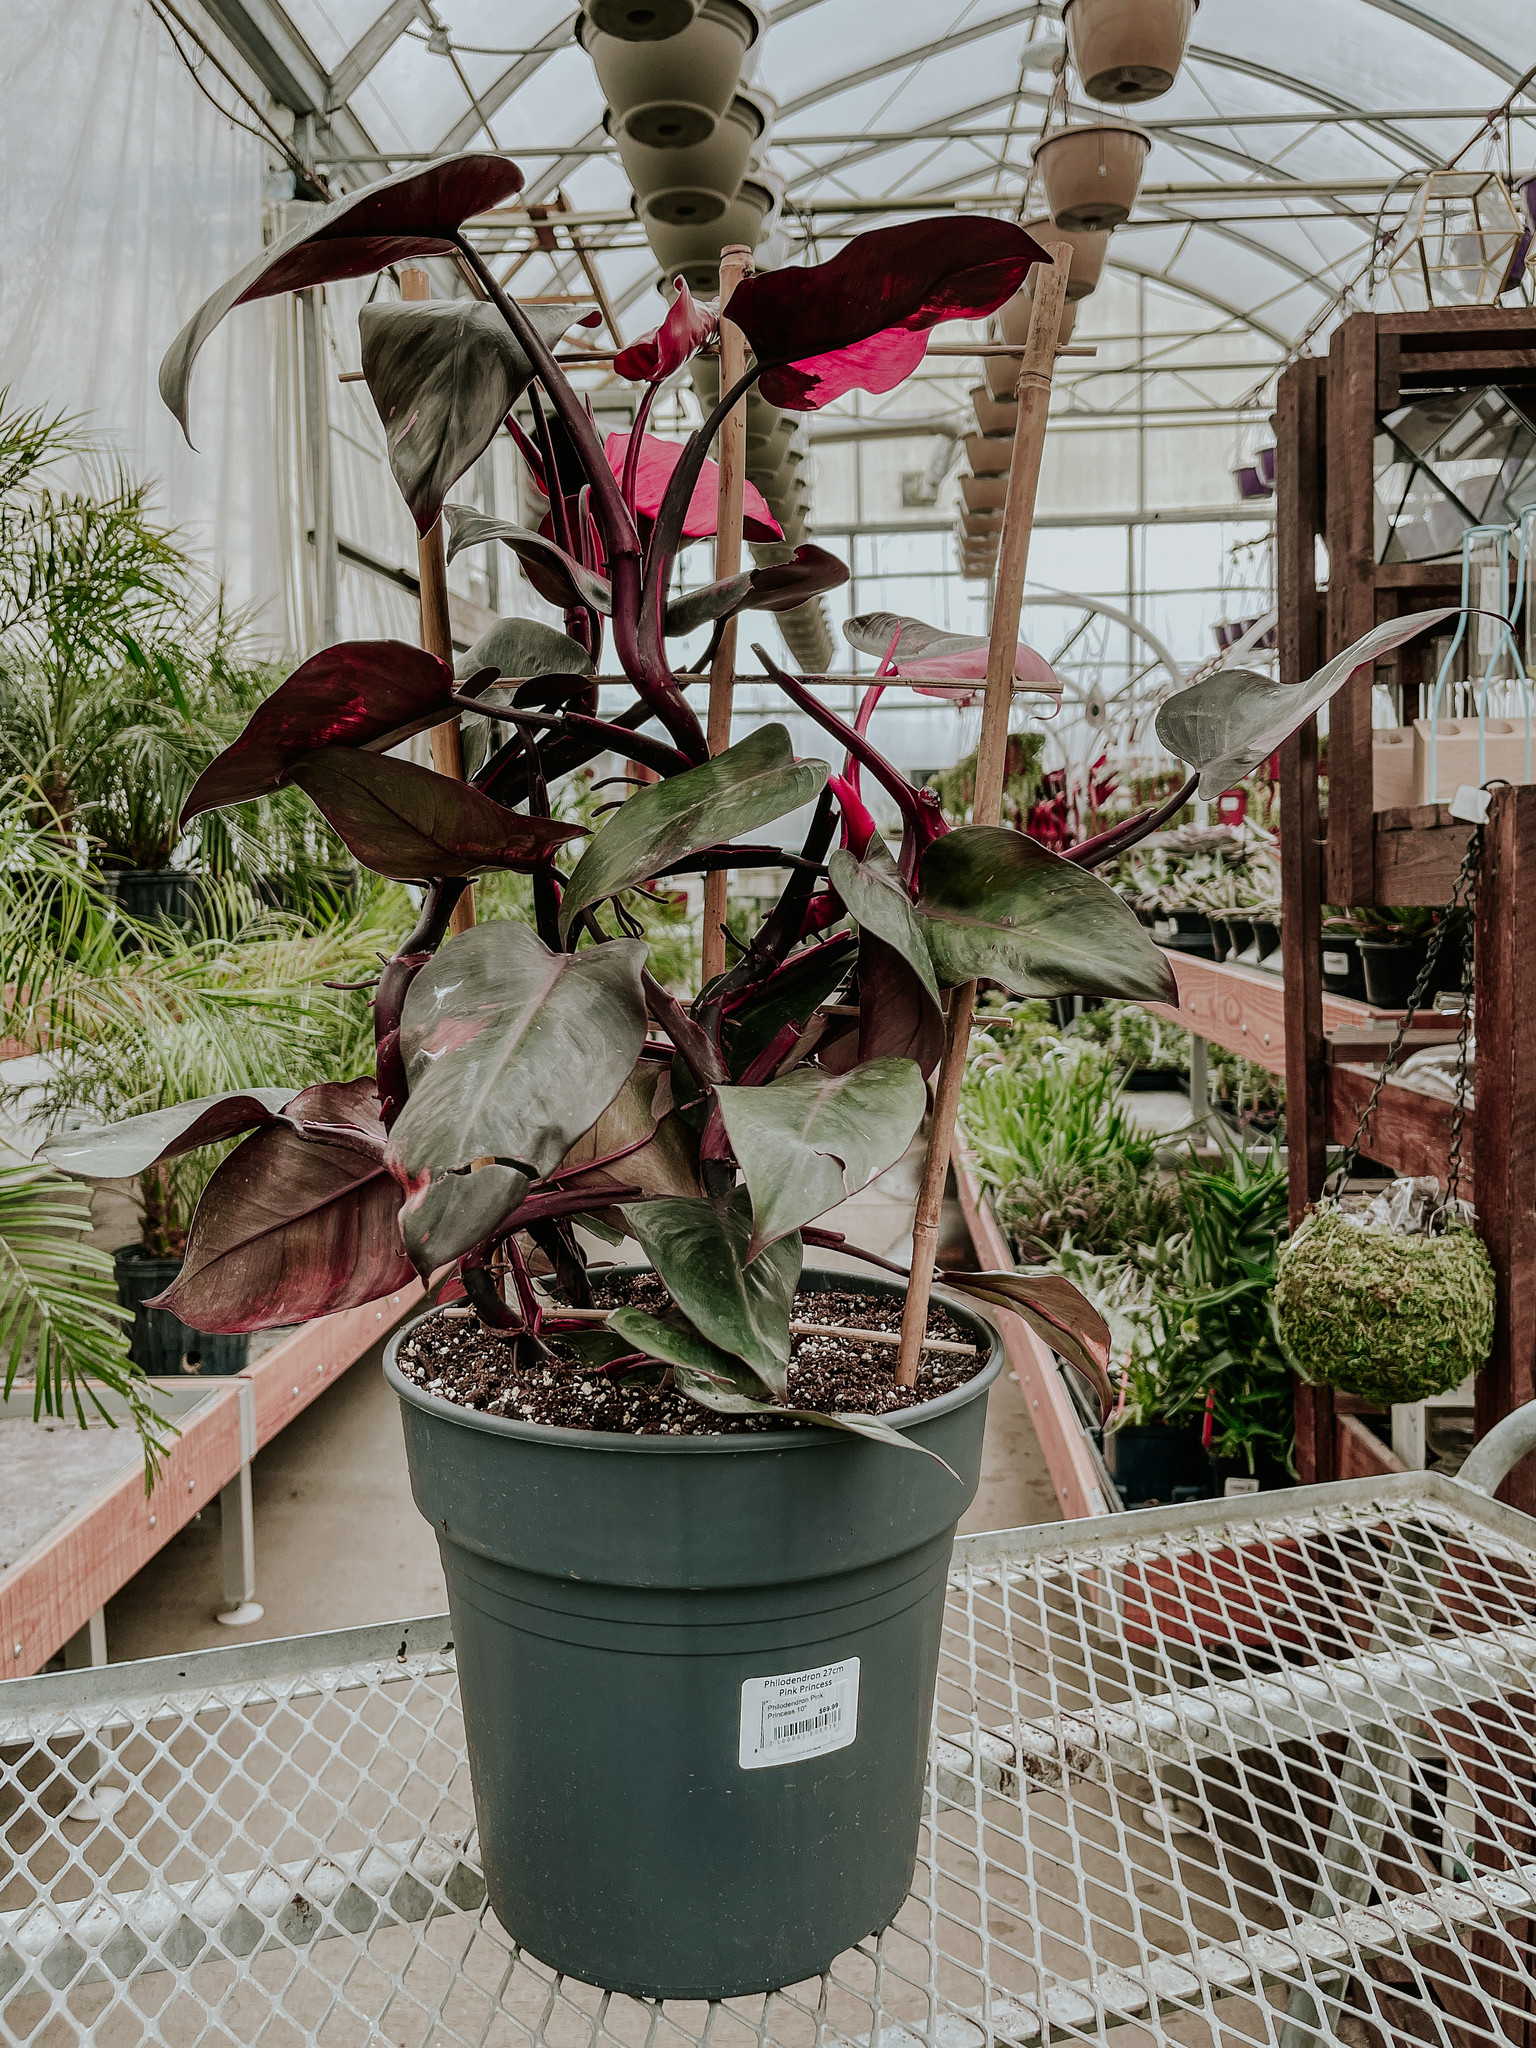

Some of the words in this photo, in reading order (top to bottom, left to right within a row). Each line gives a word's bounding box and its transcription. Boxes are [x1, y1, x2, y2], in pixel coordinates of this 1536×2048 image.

[822, 1666, 844, 1677] 27cm
[779, 1687, 798, 1696] Pink
[799, 1680, 833, 1693] Princess
[767, 1697, 809, 1711] Philodendron
[810, 1693, 823, 1701] Pink
[819, 1703, 839, 1714] $69.99
[767, 1710, 795, 1719] Princess
